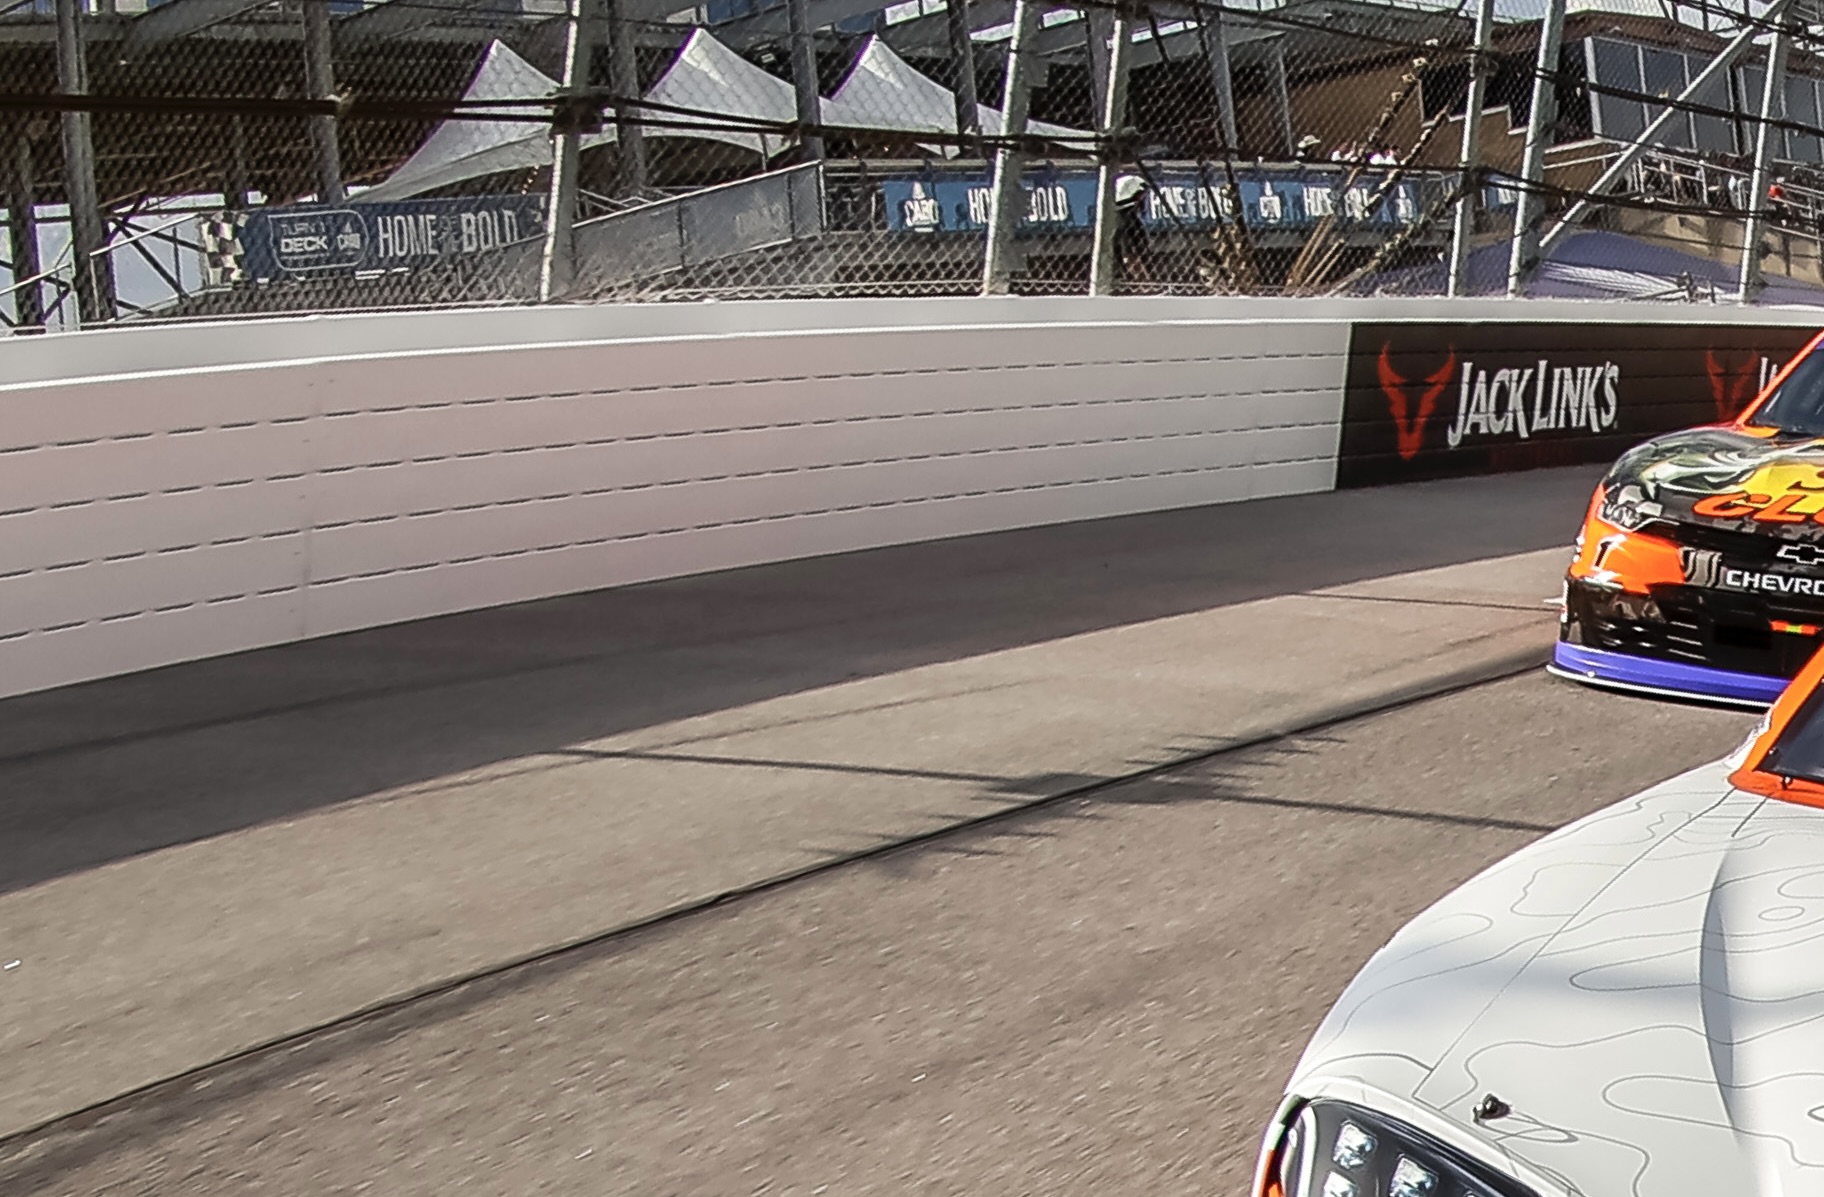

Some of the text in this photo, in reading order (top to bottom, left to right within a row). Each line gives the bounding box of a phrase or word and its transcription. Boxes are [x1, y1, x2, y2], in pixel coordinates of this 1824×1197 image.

[280, 235, 329, 254] DECK
[377, 214, 439, 259] HOME
[1447, 361, 1535, 450] JACK
